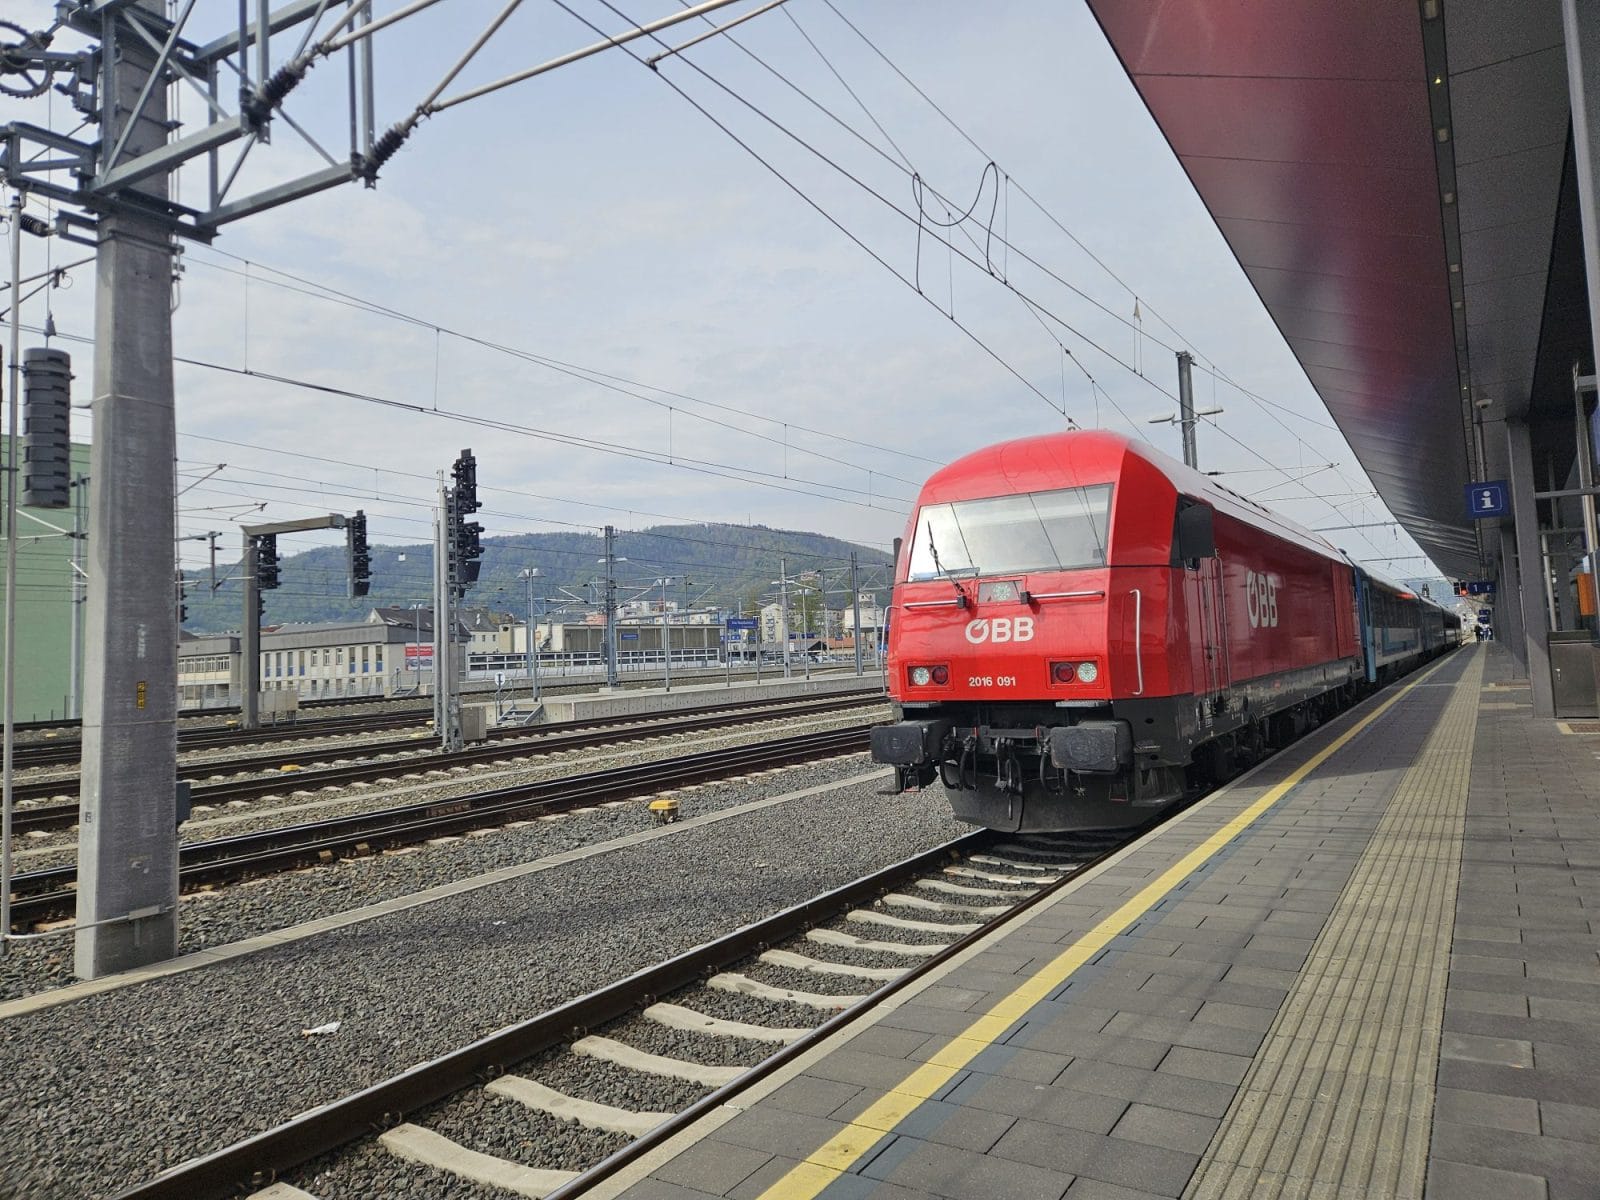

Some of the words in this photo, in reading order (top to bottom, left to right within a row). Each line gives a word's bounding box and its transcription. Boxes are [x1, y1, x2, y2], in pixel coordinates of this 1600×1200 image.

[1246, 570, 1278, 628] ÖBB
[965, 617, 1034, 644] ÖBB
[968, 676, 993, 687] 2016
[996, 676, 1016, 687] 091
